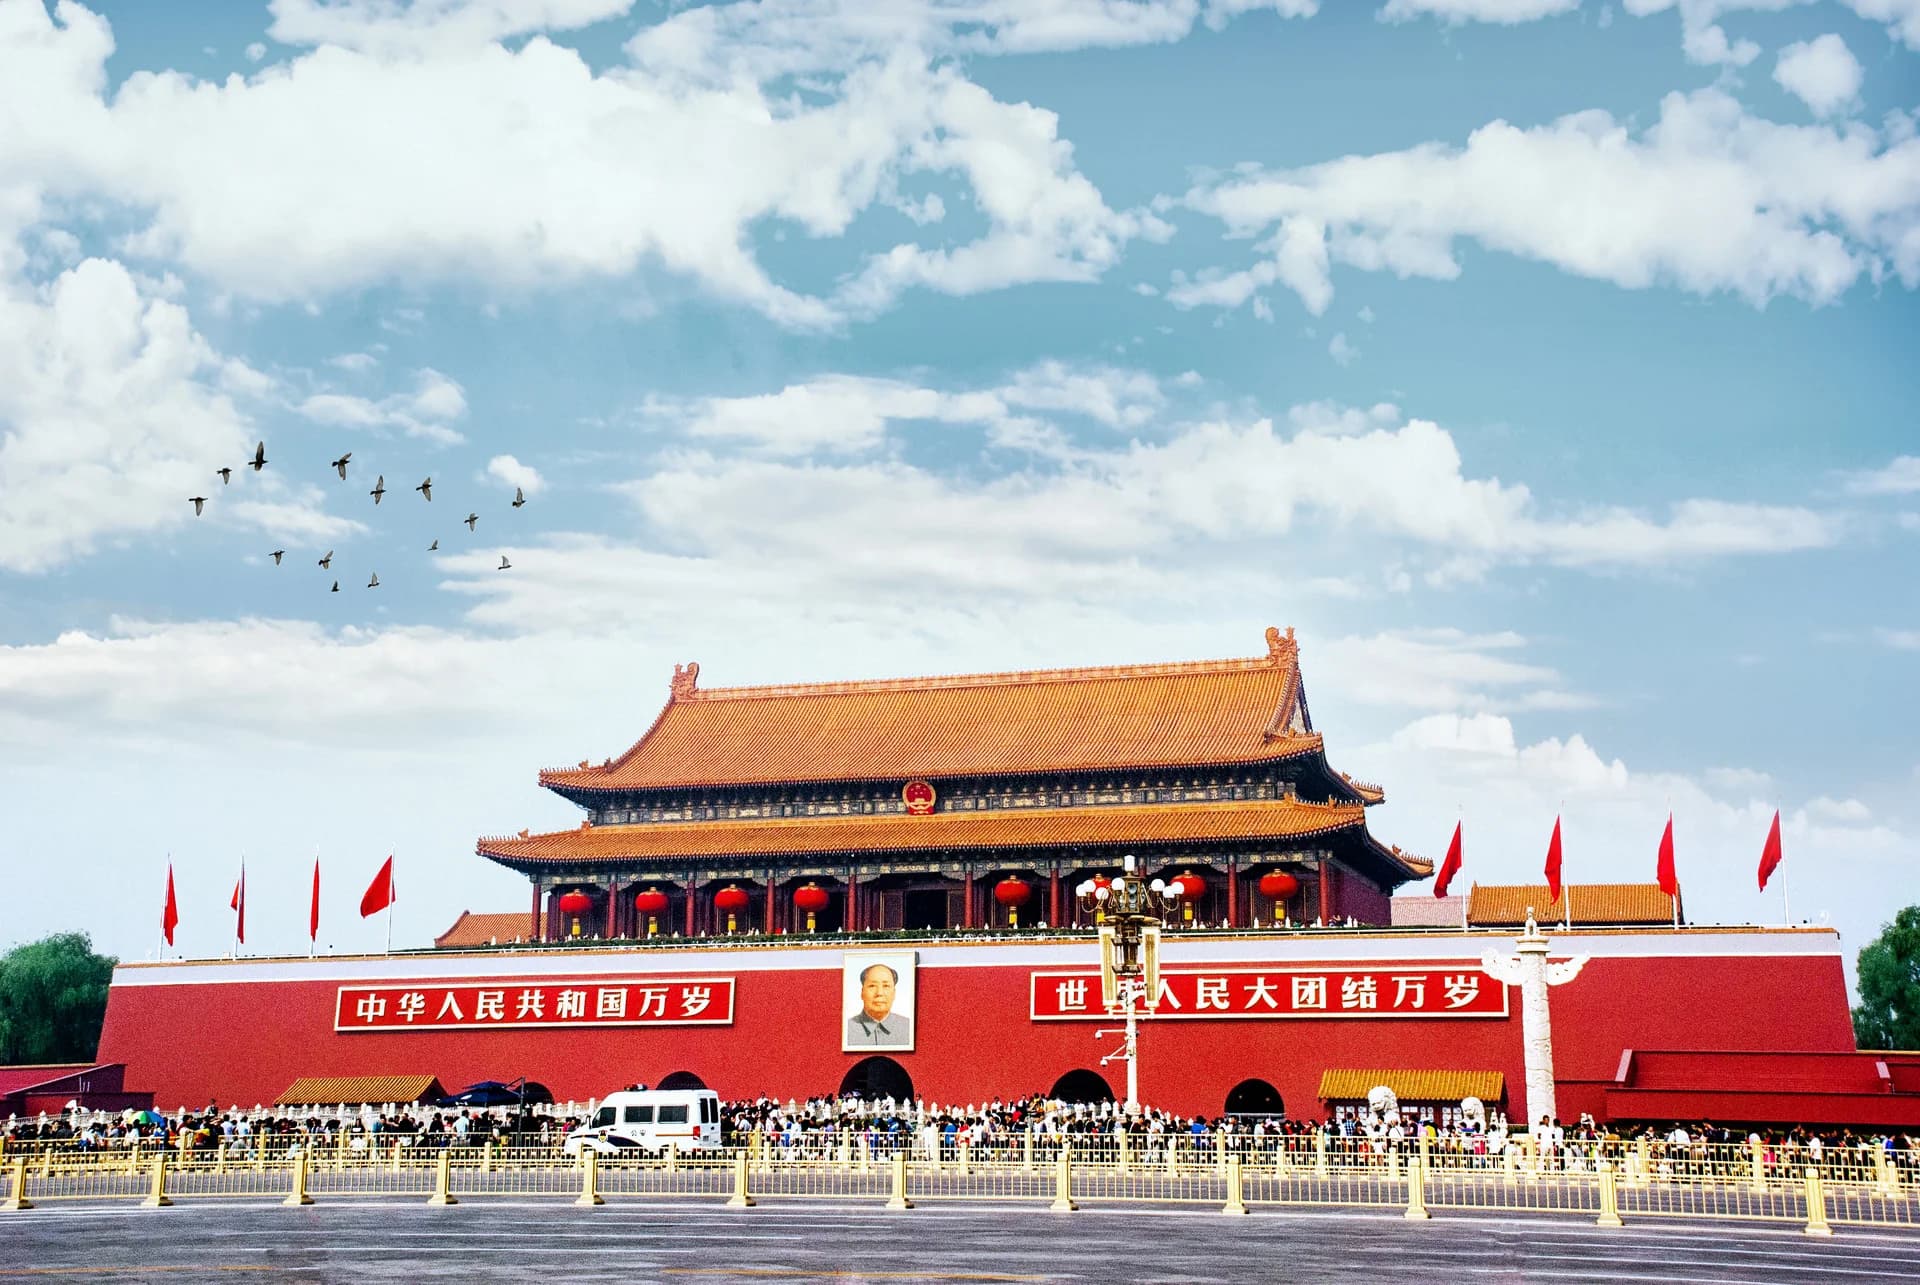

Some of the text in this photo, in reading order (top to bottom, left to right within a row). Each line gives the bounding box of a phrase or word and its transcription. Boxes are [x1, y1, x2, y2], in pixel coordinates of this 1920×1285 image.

[357, 986, 711, 1022] 中华人民共和国万岁
